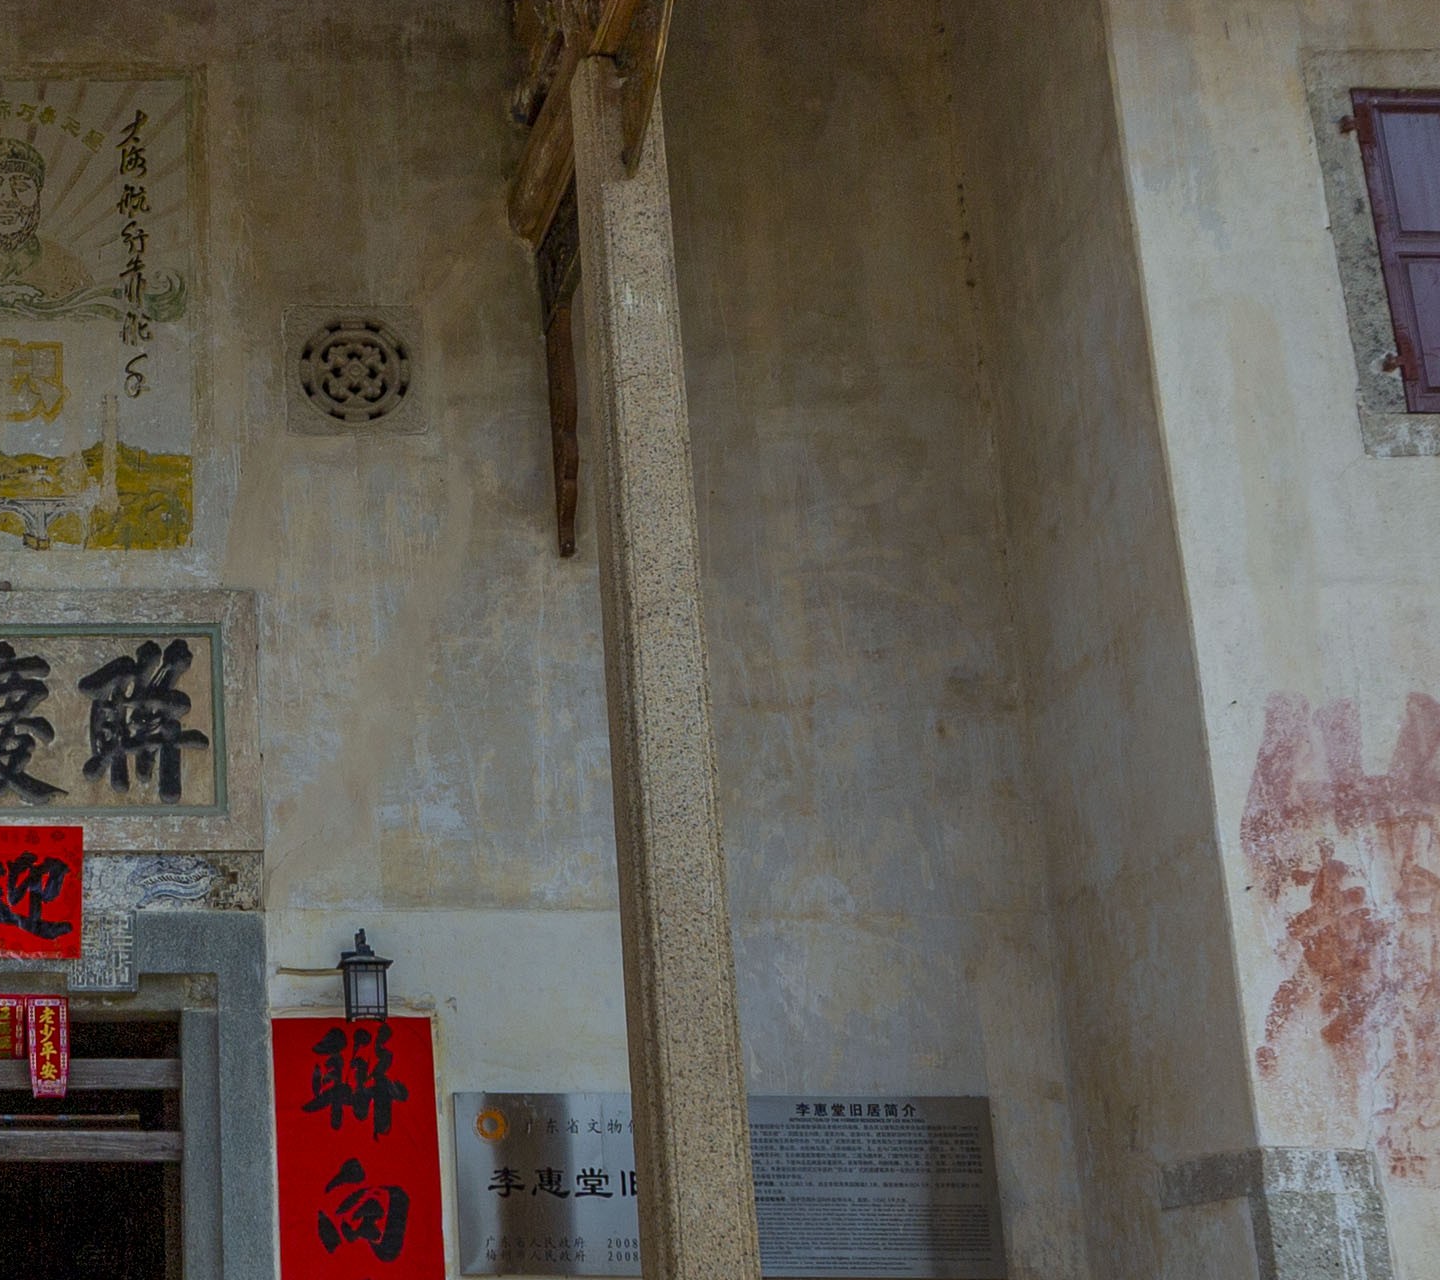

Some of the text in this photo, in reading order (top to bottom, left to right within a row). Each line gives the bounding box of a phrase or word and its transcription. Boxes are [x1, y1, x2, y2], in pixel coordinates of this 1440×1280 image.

[38, 1006, 58, 1081] 老少平安
[795, 1102, 917, 1118] 李惠堂旧居简介
[607, 1237, 639, 1249] 2008
[607, 1250, 639, 1262] 2008
